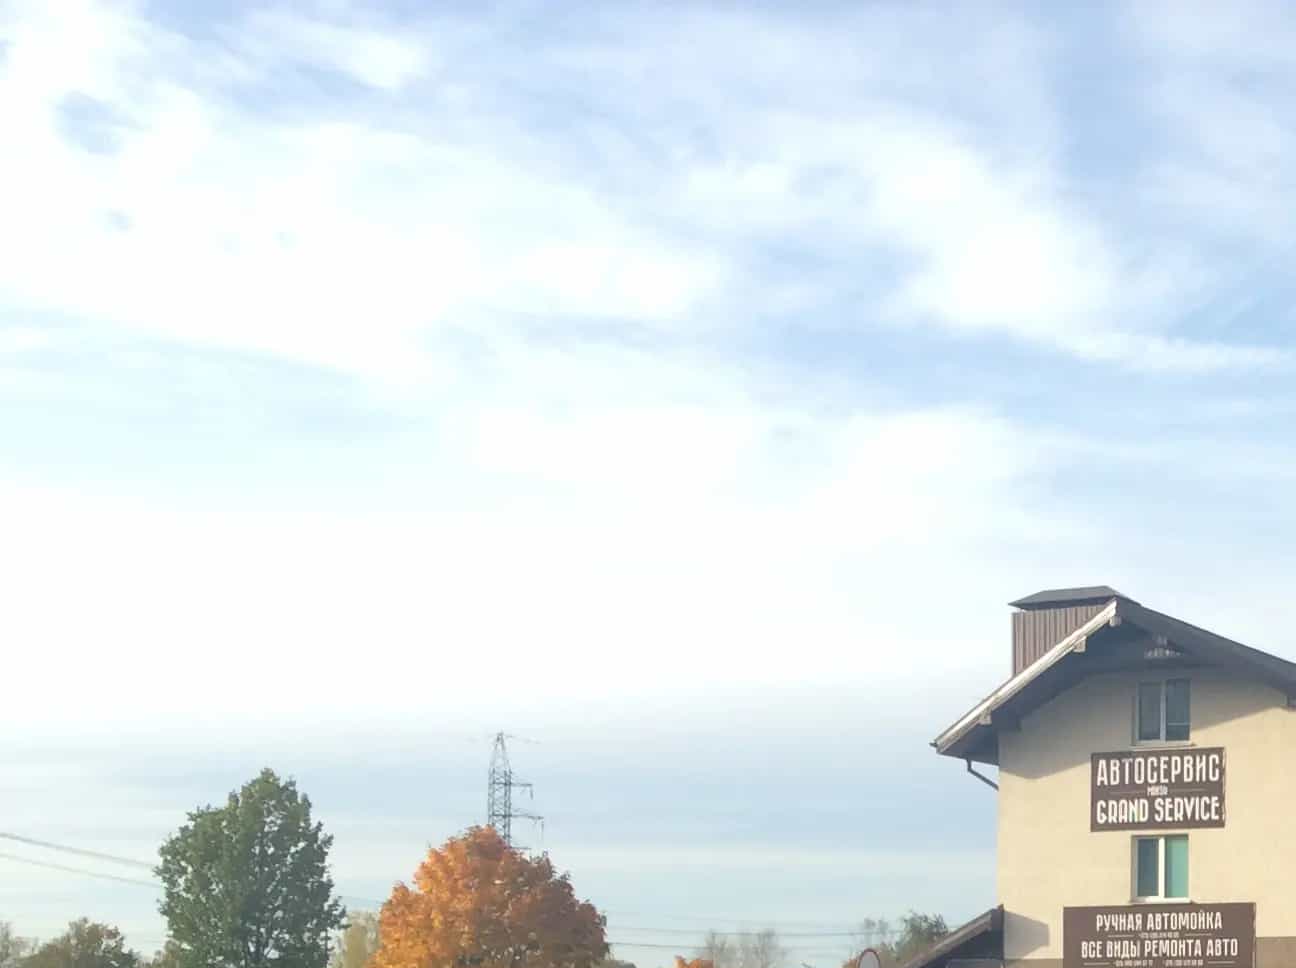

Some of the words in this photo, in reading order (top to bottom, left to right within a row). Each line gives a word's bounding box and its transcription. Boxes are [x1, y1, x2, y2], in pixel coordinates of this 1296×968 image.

[1096, 754, 1219, 786] АВТОСЕРВИС
[1096, 798, 1149, 824] GRAND
[1154, 796, 1219, 822] SERVICE
[1096, 913, 1142, 932] РУЧНАЯ
[1147, 910, 1222, 931] АВТОМОЙКА
[1081, 941, 1103, 958] ВСЕ
[1106, 940, 1140, 959] ВИДЫ
[1144, 939, 1202, 957] РЕМОНТА
[1206, 938, 1238, 956] АВТО
